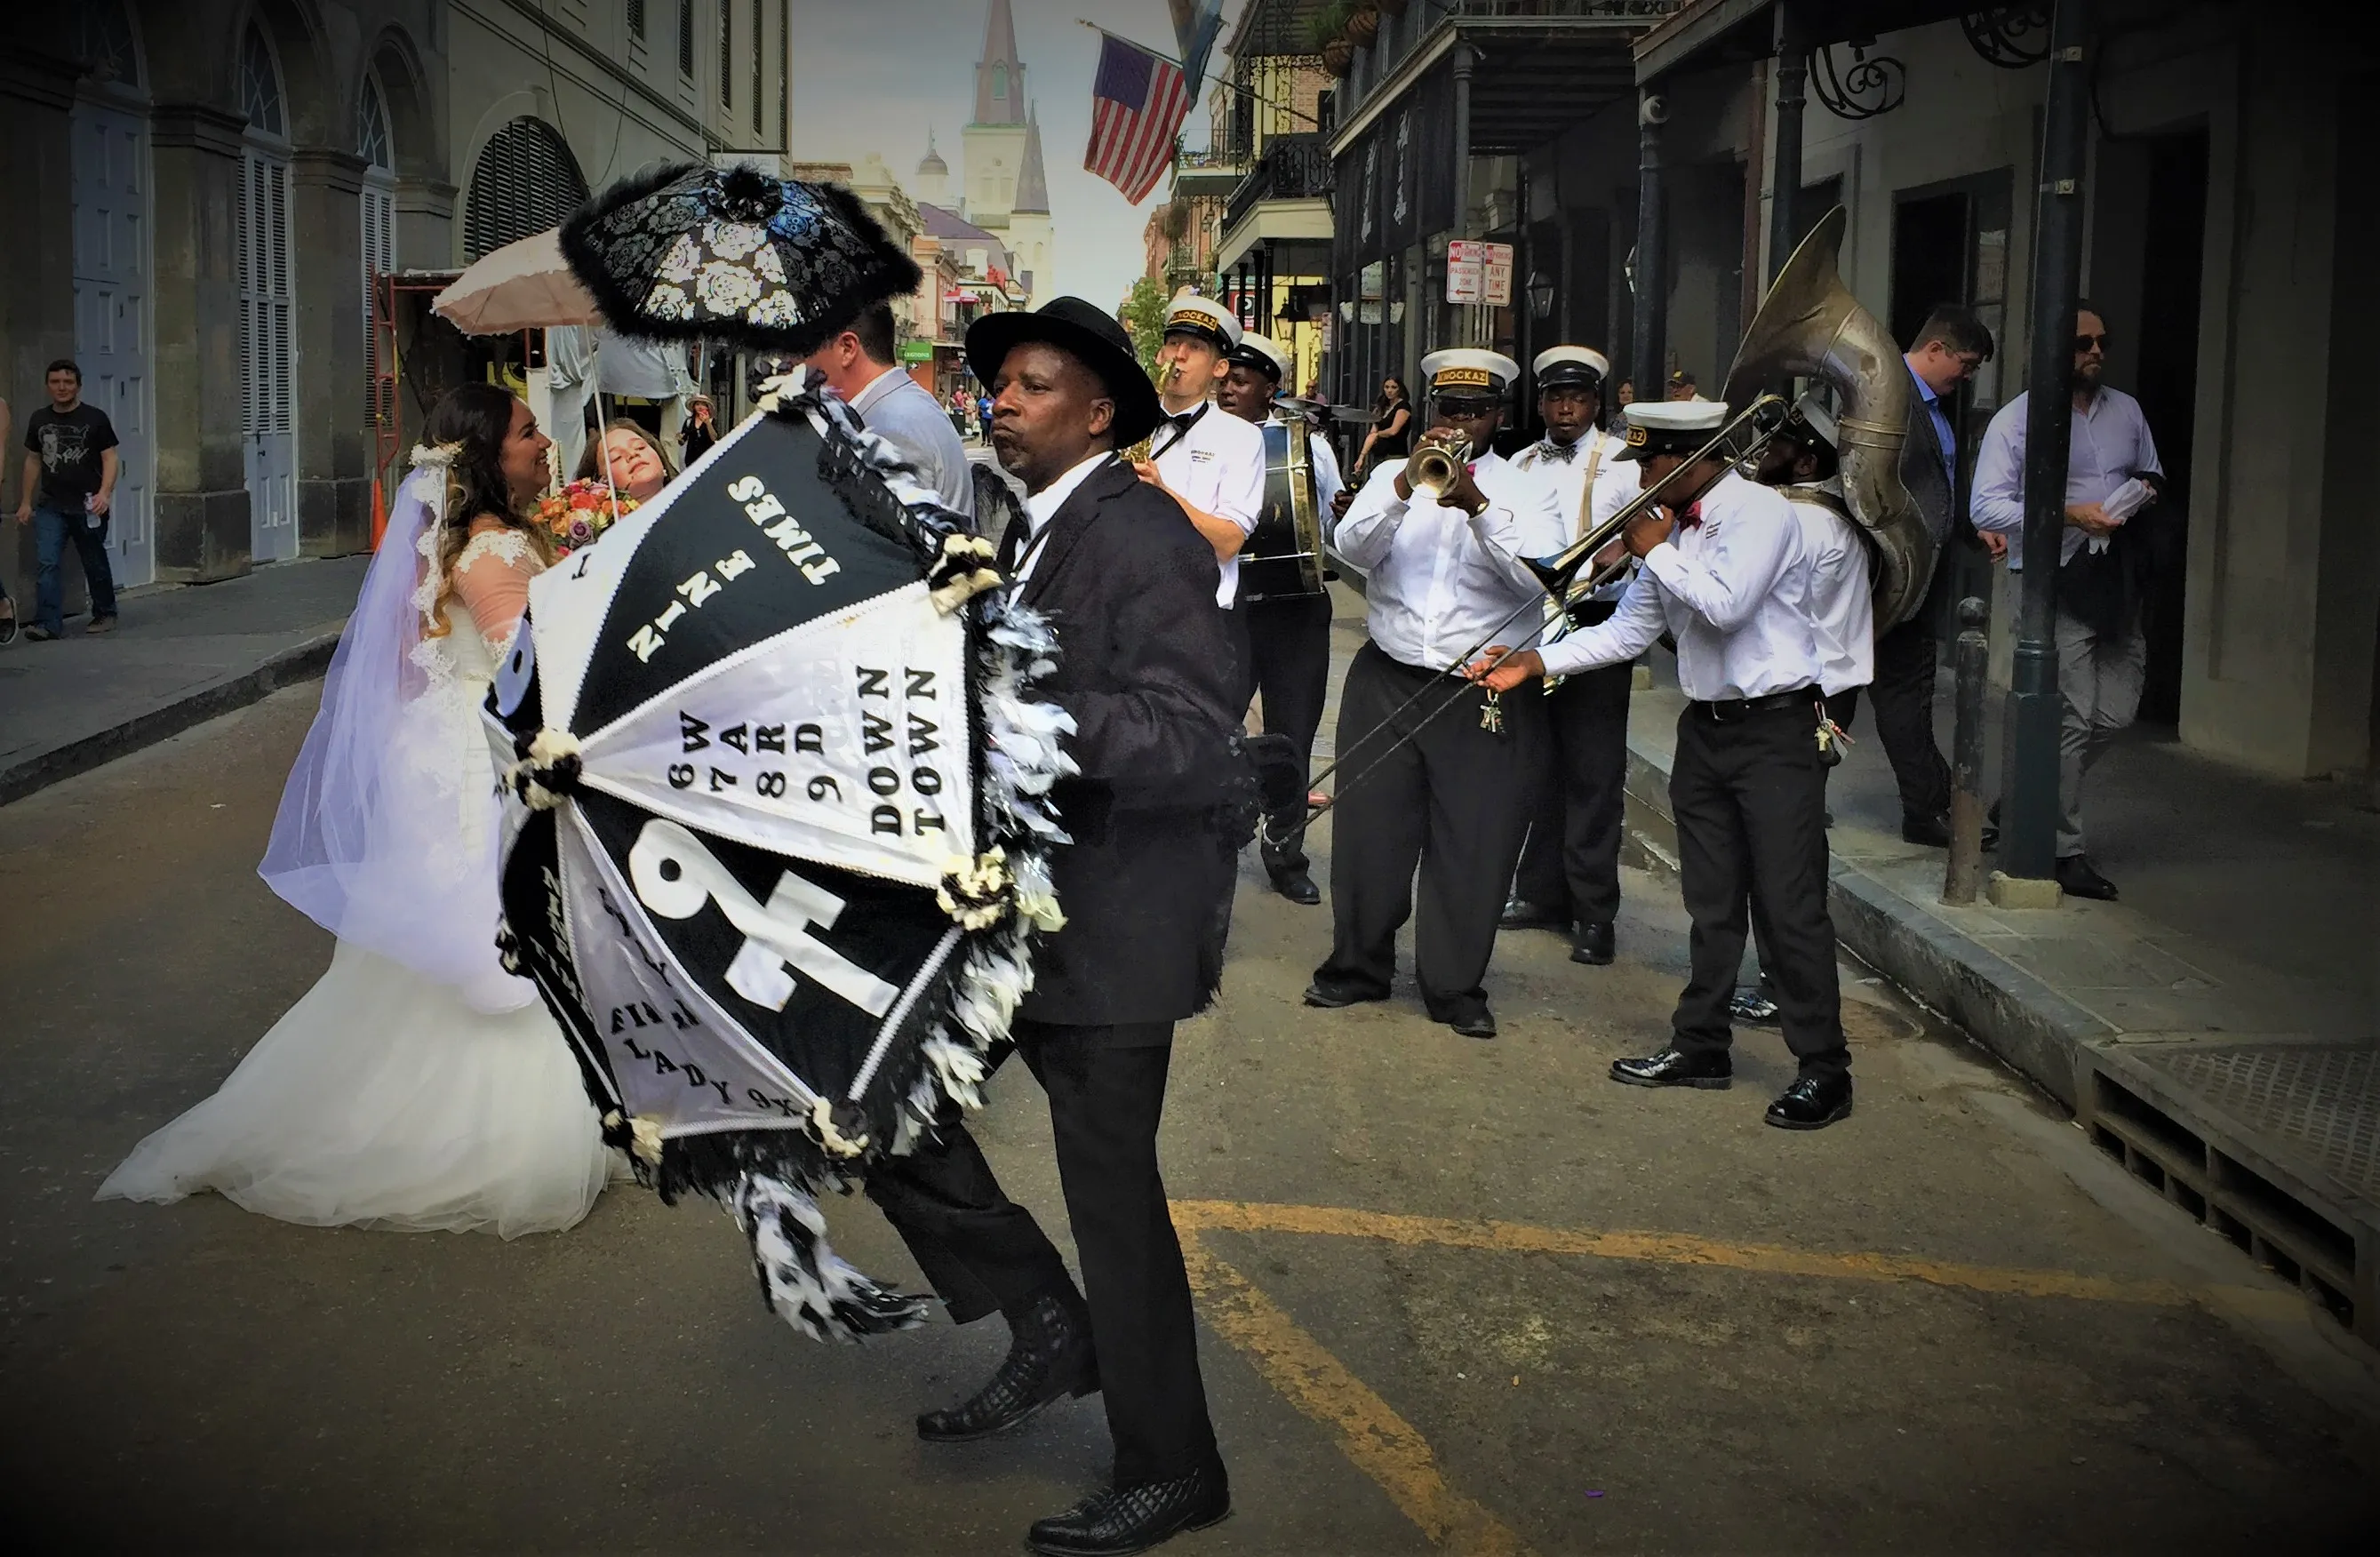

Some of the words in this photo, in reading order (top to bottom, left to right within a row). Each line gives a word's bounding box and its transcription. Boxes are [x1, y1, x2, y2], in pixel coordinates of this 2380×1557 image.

[1450, 246, 1460, 258] NO
[1461, 248, 1480, 257] PARKING
[1489, 266, 1505, 277] ANY
[1489, 279, 1505, 291] TIME
[727, 475, 841, 586] TIMES
[626, 549, 756, 664] NINE
[856, 664, 902, 837] DOWN
[905, 665, 946, 836] TOWN
[623, 1037, 734, 1106] LADY
